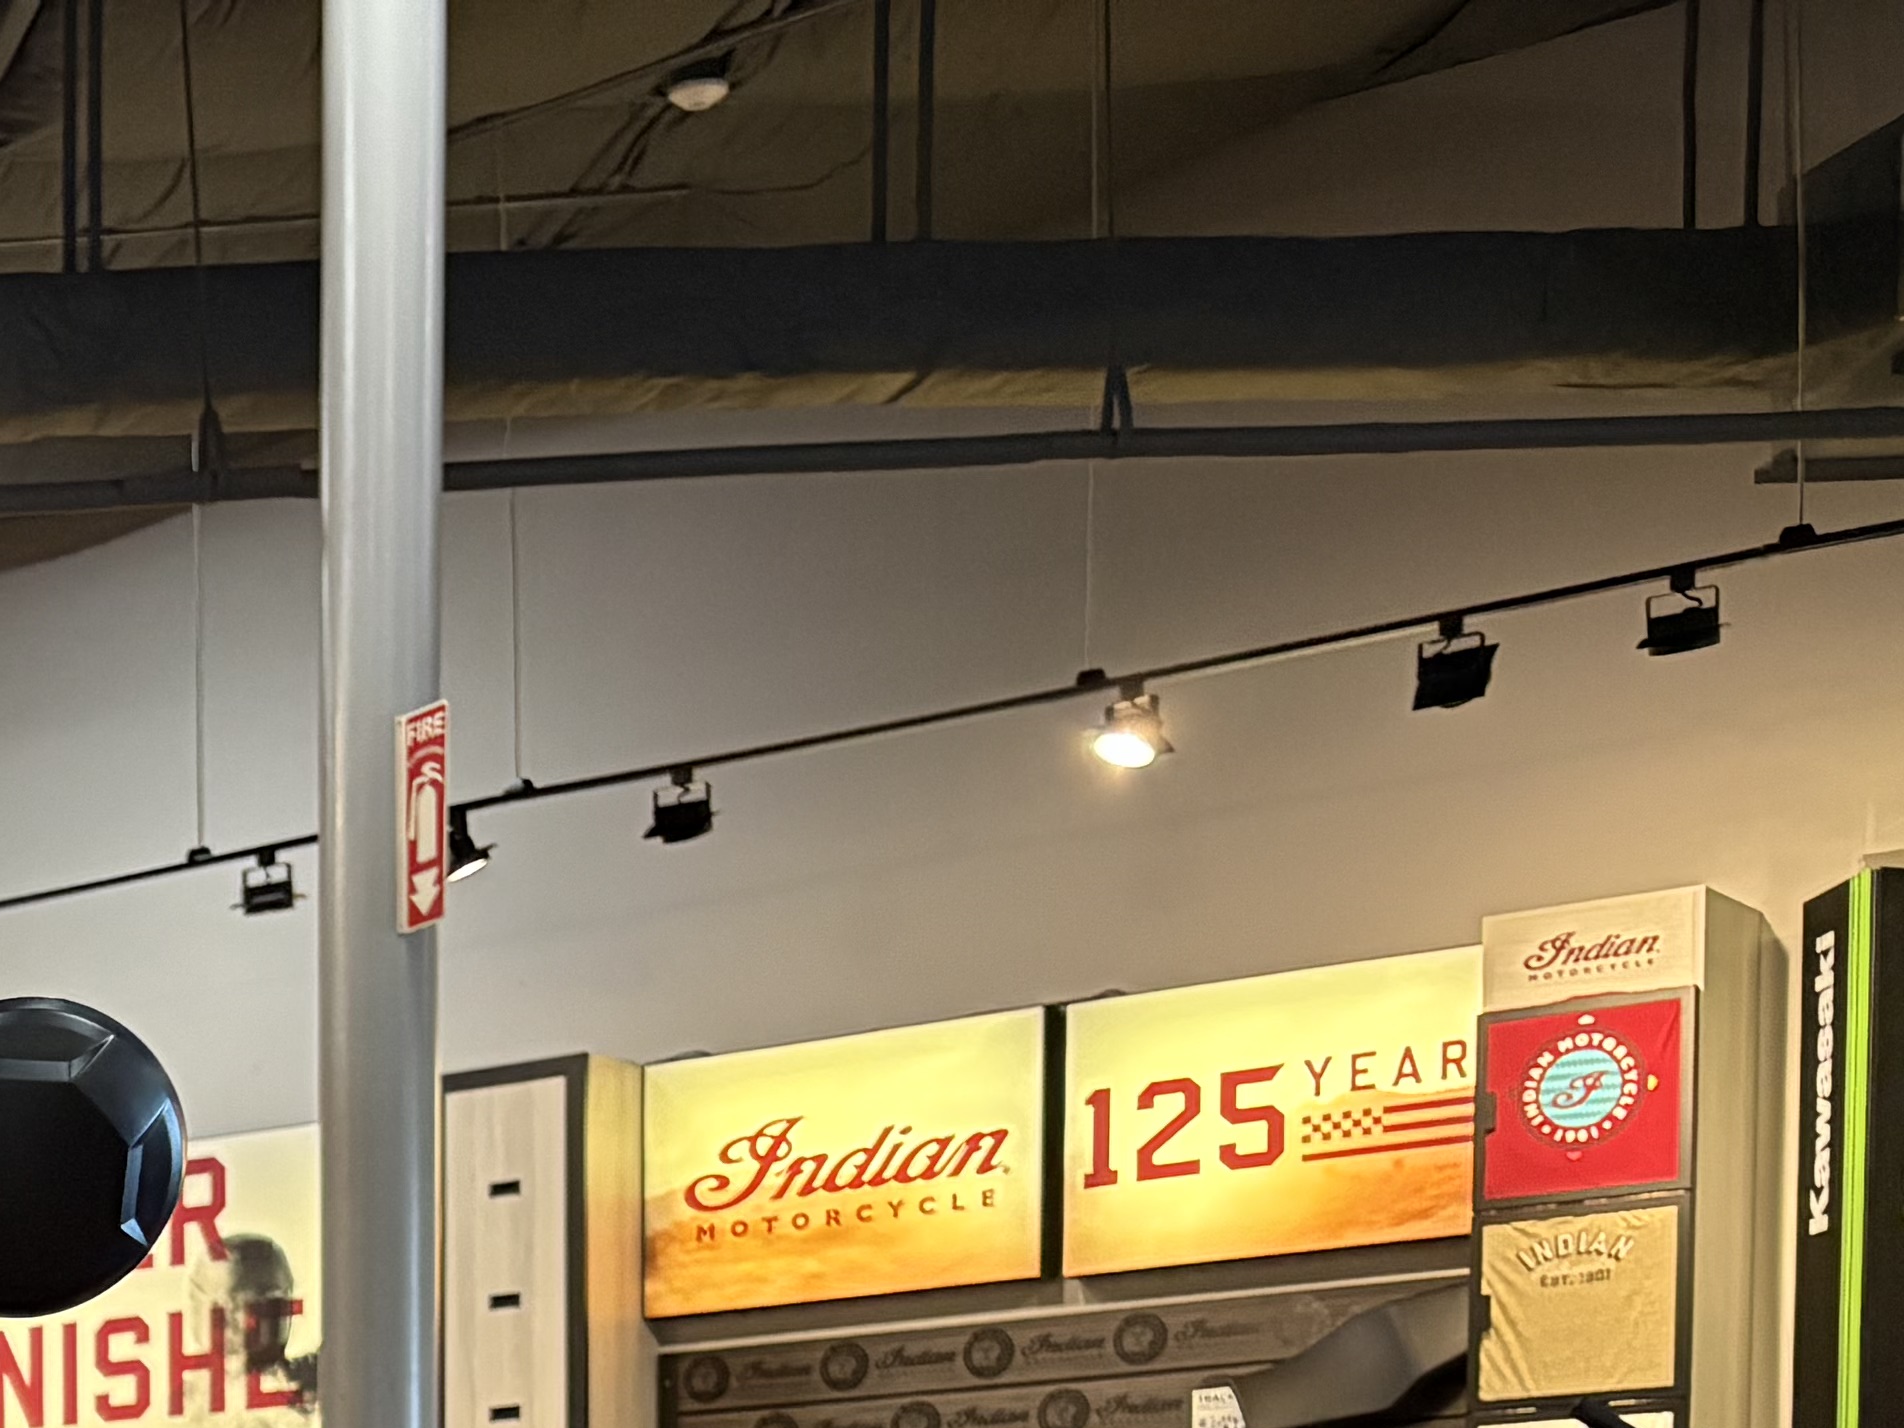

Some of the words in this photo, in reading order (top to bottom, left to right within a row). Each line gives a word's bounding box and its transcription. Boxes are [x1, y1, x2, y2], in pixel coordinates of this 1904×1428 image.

[407, 711, 445, 748] FIRE
[1523, 931, 1661, 971] Indian
[1527, 957, 1655, 982] MOTORCYCLE
[1522, 1051, 1555, 1127] INDIAN
[1557, 1033, 1639, 1120] MOTORCYCLE
[1808, 930, 1835, 1235] Kawasaki
[1083, 1063, 1287, 1189] 125
[683, 1115, 1012, 1212] Indian
[695, 1188, 997, 1243] MOTORCYCLE
[1516, 1231, 1634, 1272] INDIAN
